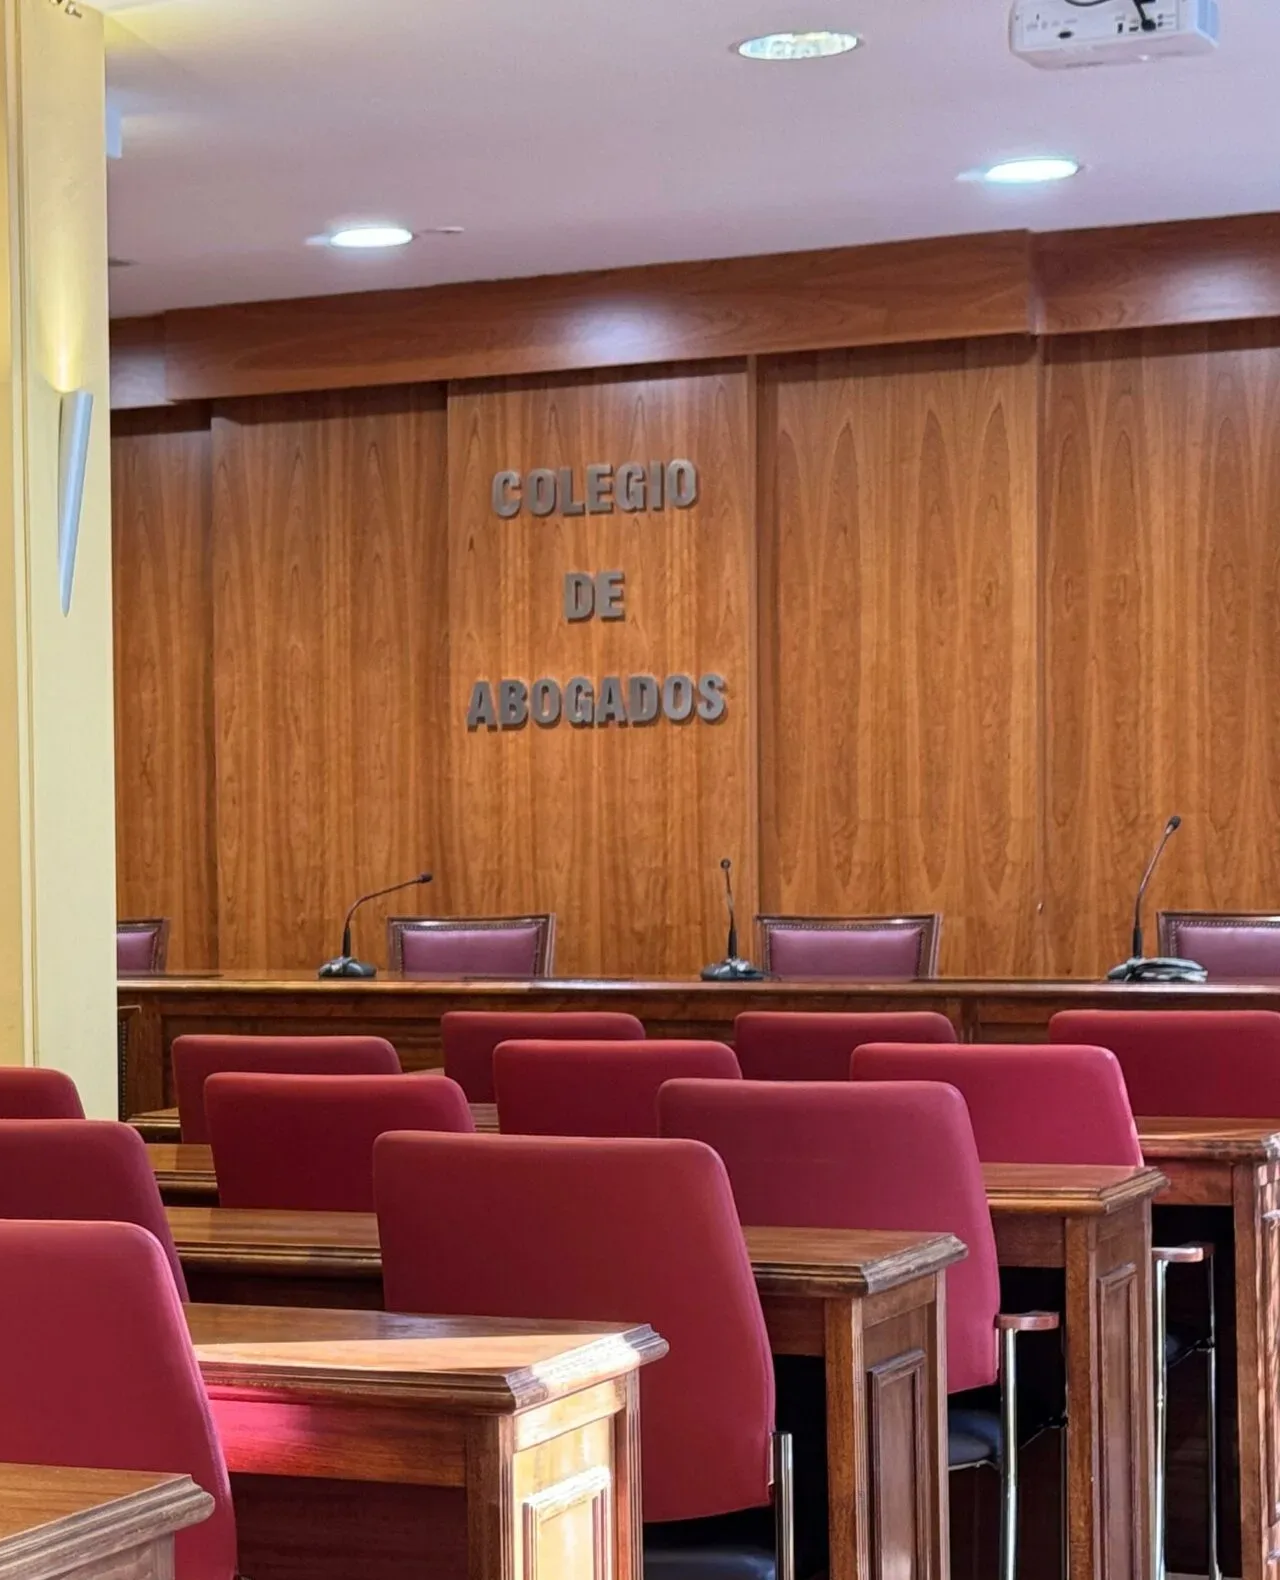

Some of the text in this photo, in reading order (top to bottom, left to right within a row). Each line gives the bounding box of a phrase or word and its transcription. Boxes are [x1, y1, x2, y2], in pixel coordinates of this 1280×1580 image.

[491, 458, 698, 518] COLEGIO
[563, 570, 625, 622] DE
[467, 673, 729, 731] ABOGADOS
